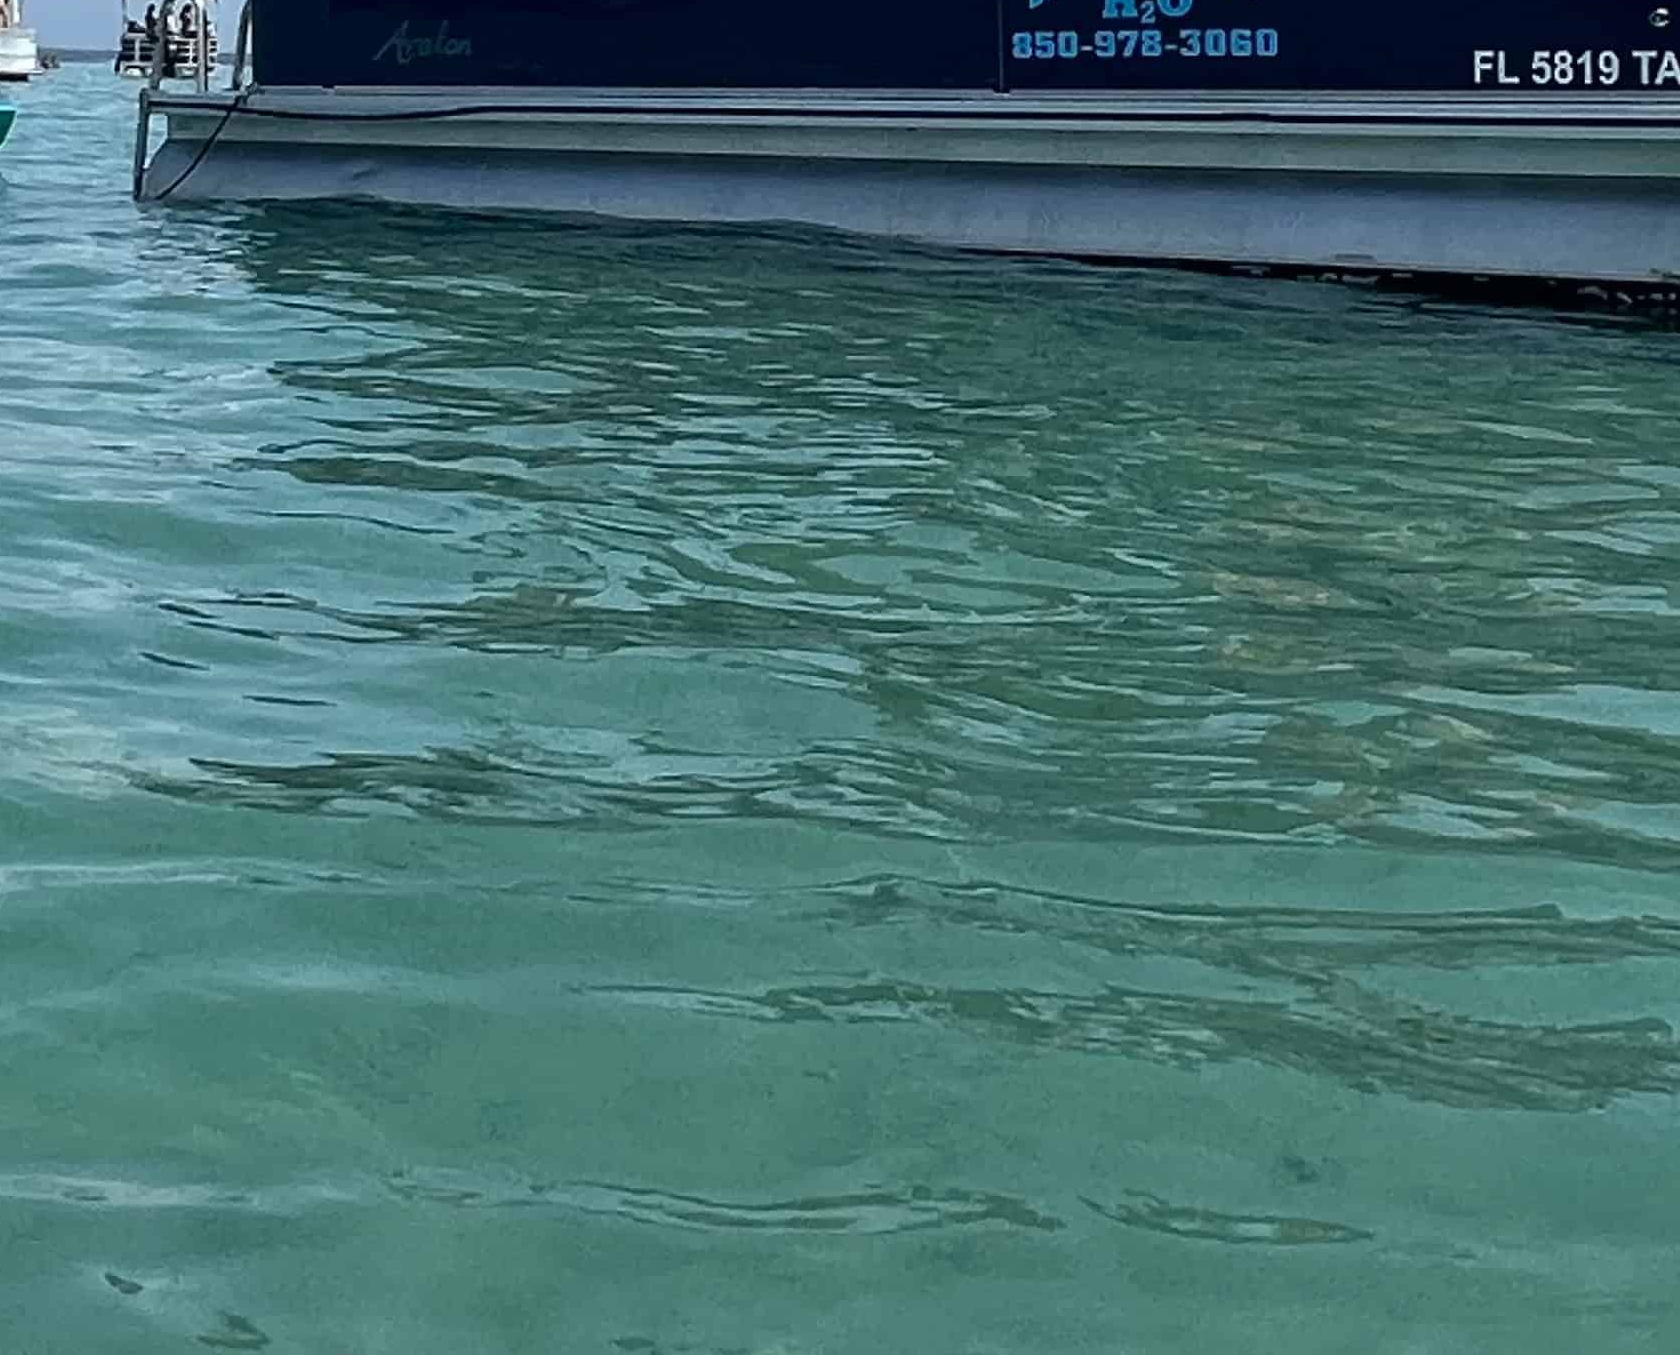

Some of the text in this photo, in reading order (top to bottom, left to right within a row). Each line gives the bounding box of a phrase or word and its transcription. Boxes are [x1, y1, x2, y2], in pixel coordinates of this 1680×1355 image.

[1012, 28, 1278, 59] 850-978-3060
[1473, 49, 1520, 84] FL
[1531, 49, 1620, 85] 5819
